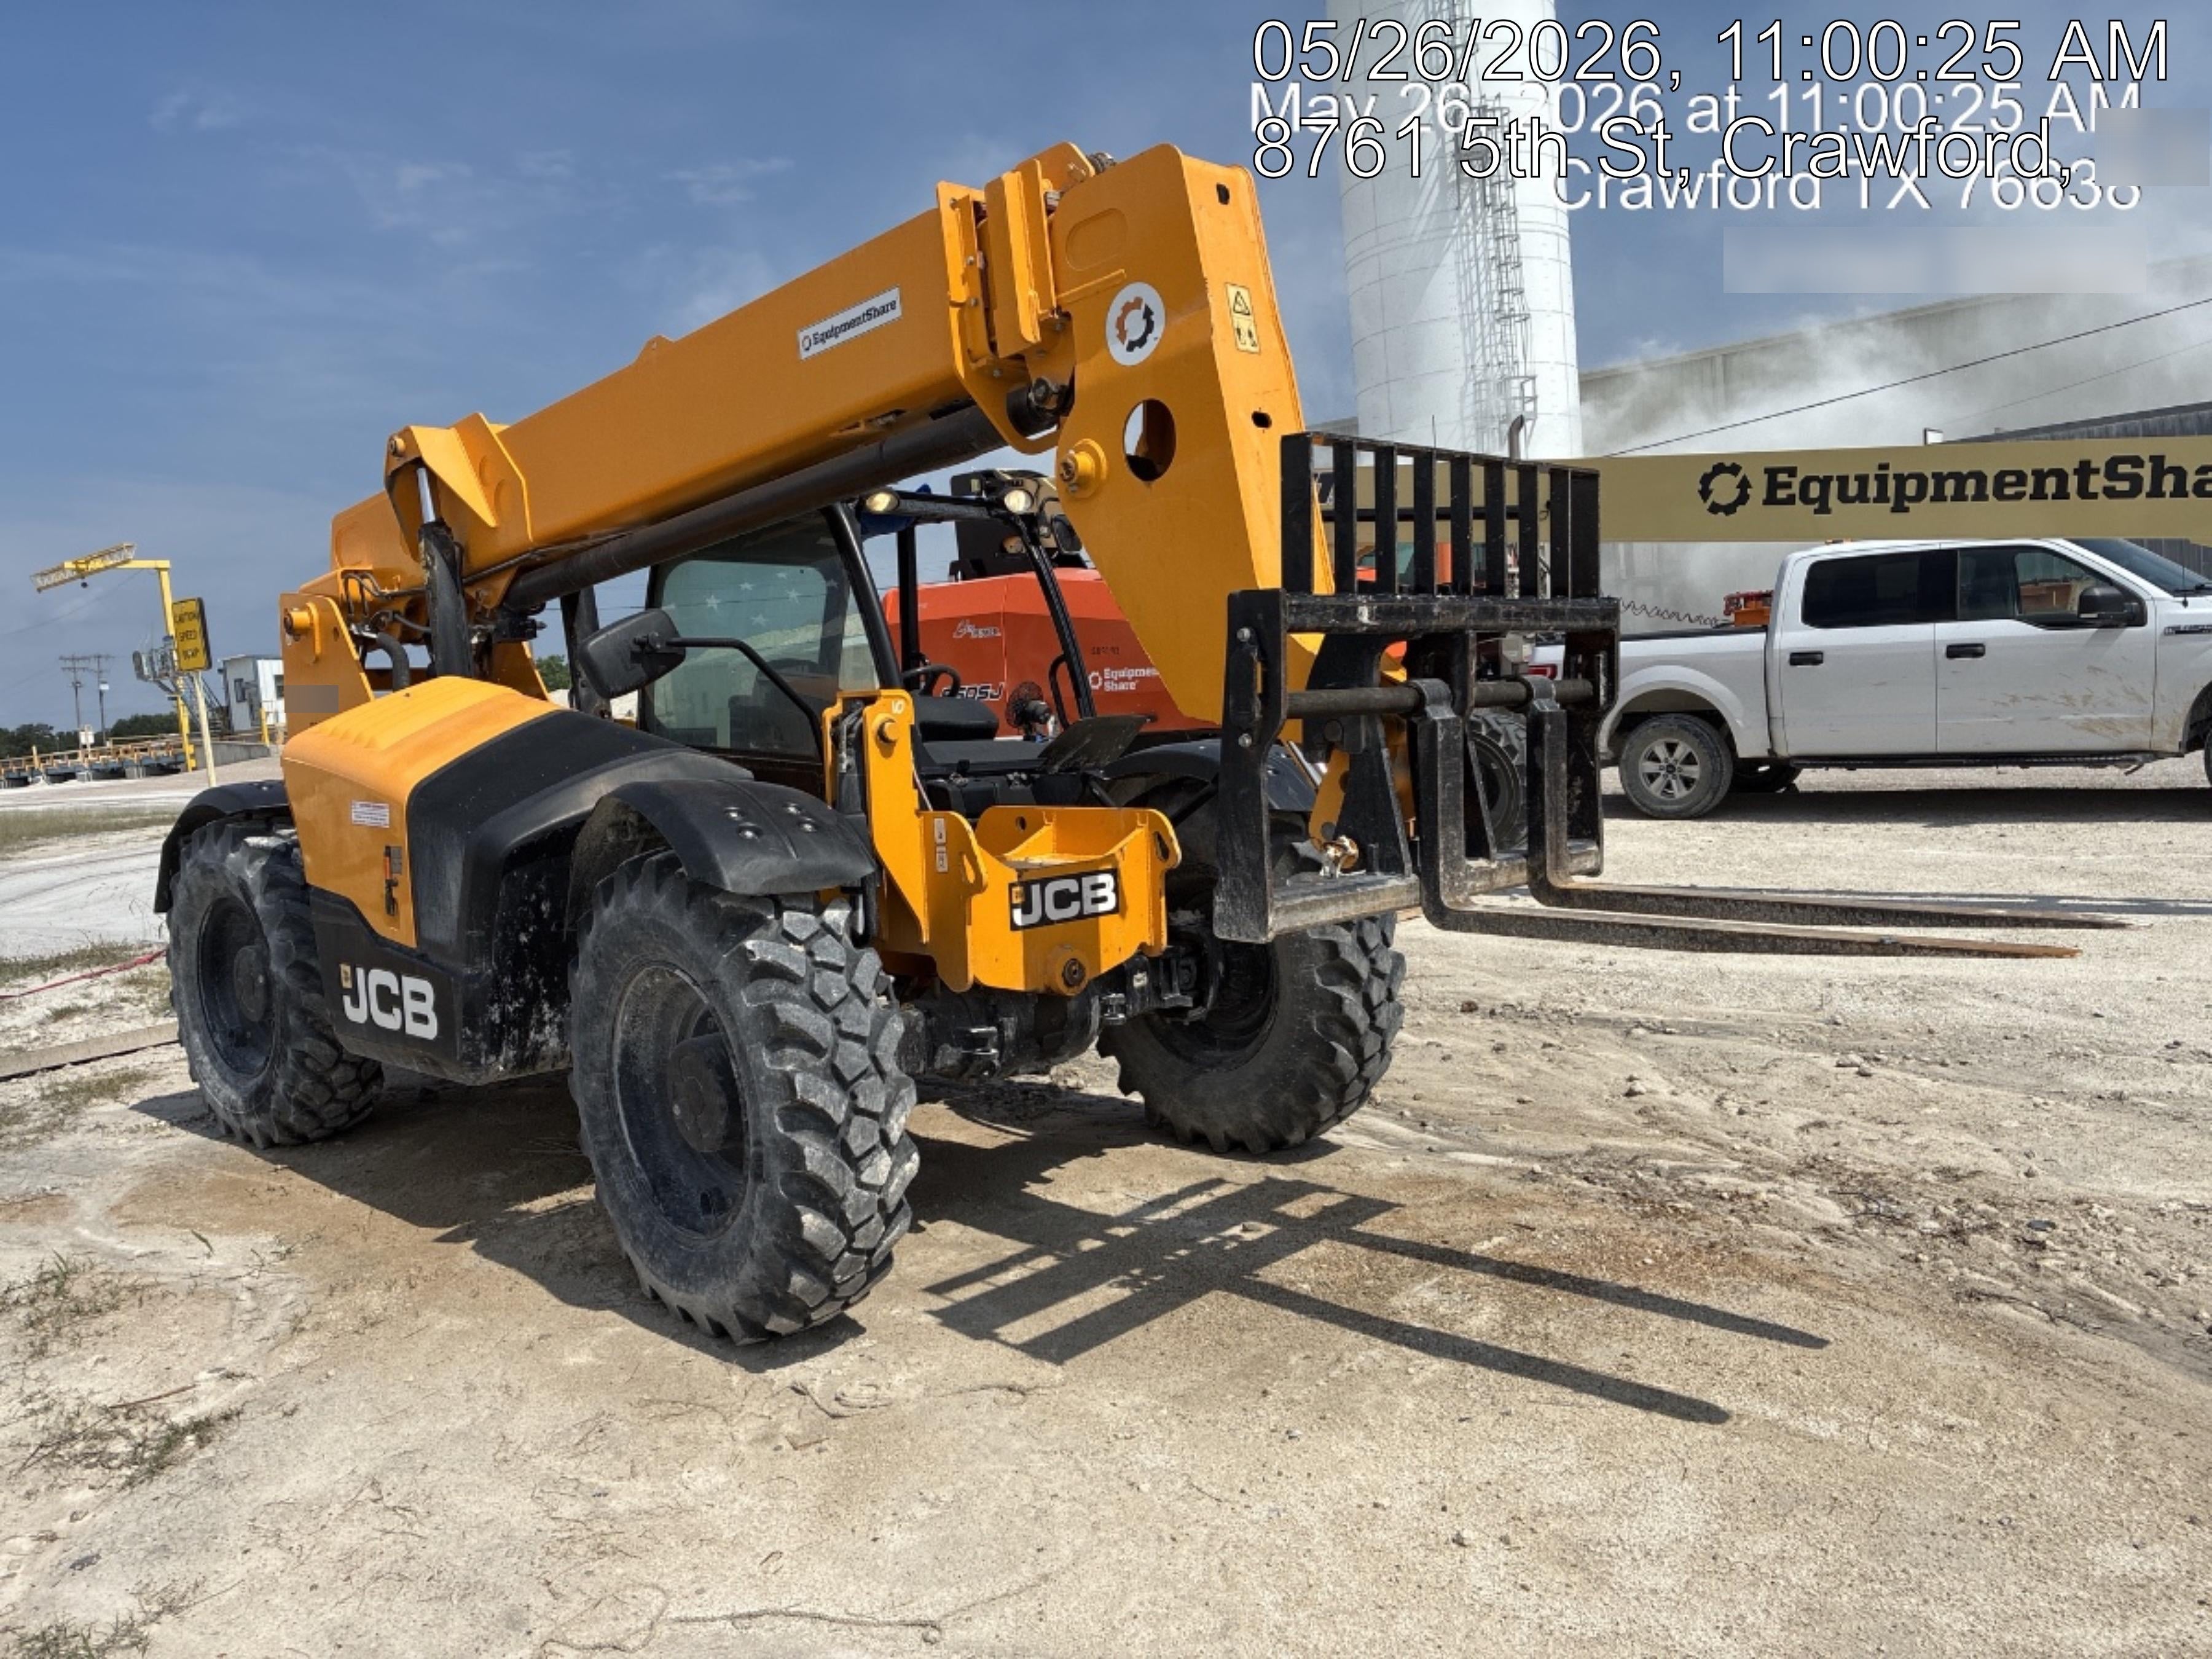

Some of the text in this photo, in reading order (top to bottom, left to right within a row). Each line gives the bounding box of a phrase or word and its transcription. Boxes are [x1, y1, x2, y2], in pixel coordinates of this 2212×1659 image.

[812, 299, 896, 345] EquipmentShare
[1104, 667, 1160, 680] Equipmen
[1104, 680, 1136, 692] Share
[1013, 873, 1116, 927] JCB
[342, 967, 437, 1040] JCB
